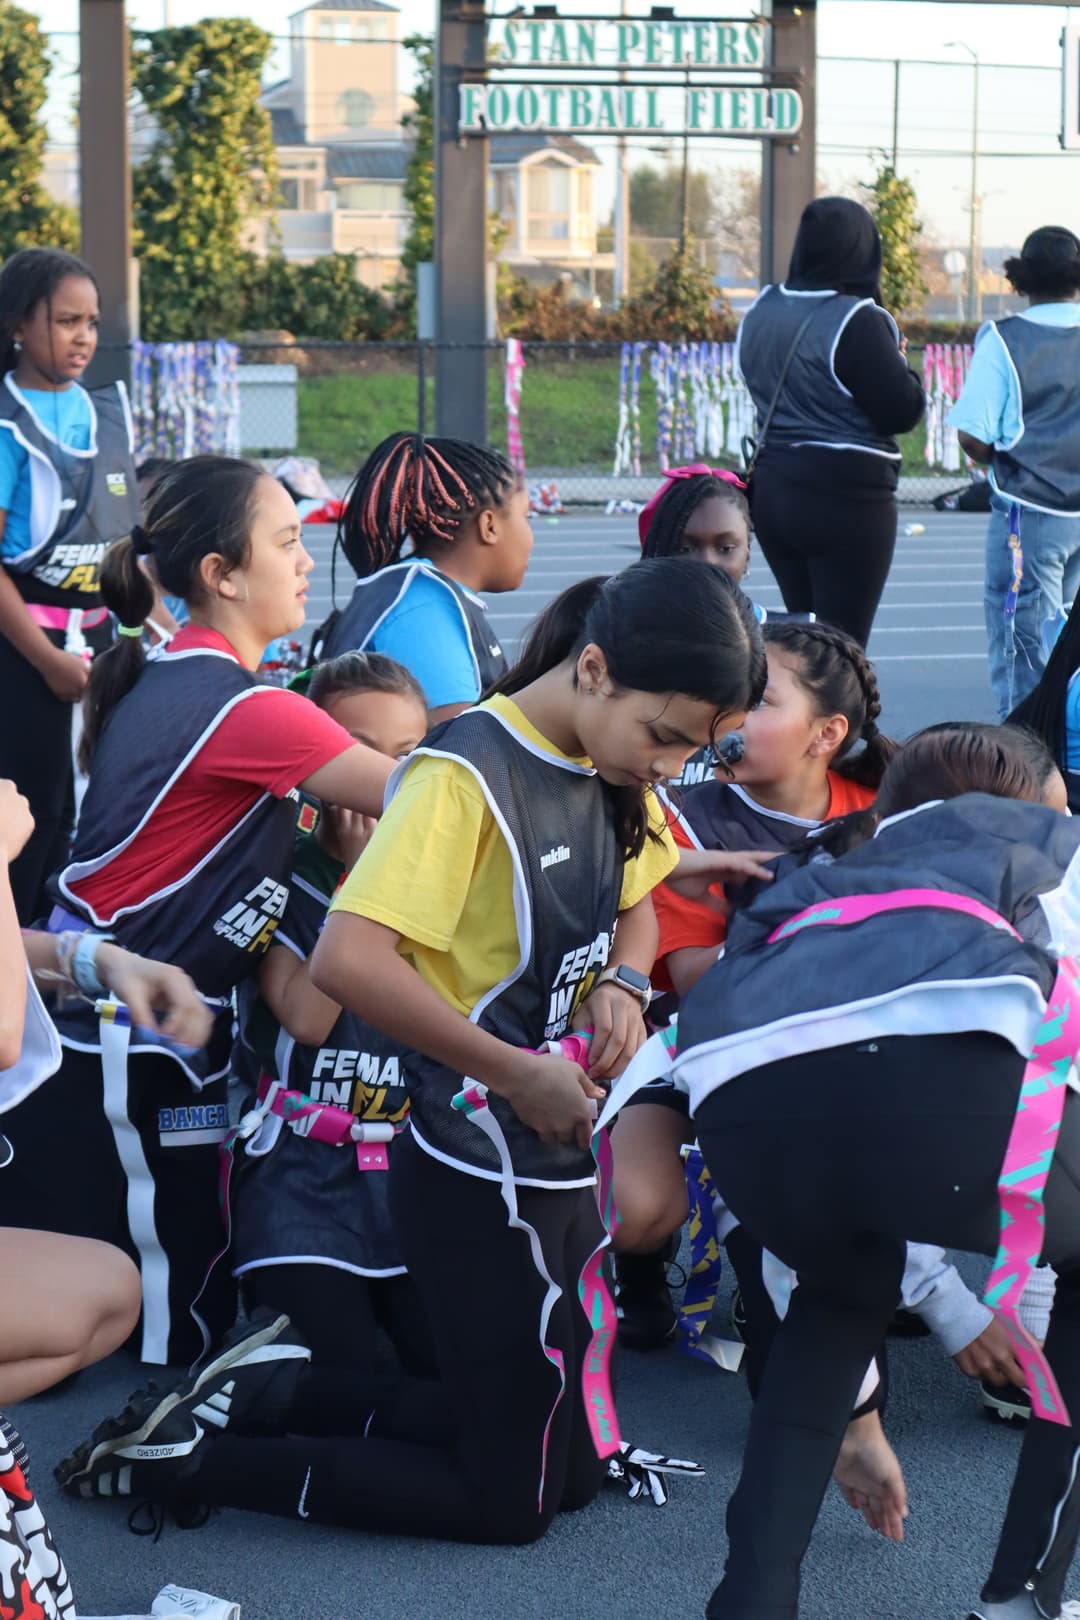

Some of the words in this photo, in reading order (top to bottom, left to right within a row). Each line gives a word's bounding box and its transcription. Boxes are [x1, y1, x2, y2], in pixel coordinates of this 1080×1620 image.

[499, 22, 597, 64] STAN
[616, 21, 763, 66] PETERS
[463, 85, 667, 130] FOOTBALL
[687, 87, 800, 131] FIELD
[221, 901, 269, 938] IN
[309, 1080, 353, 1104] IN
[136, 1446, 176, 1457] ADIZERO
